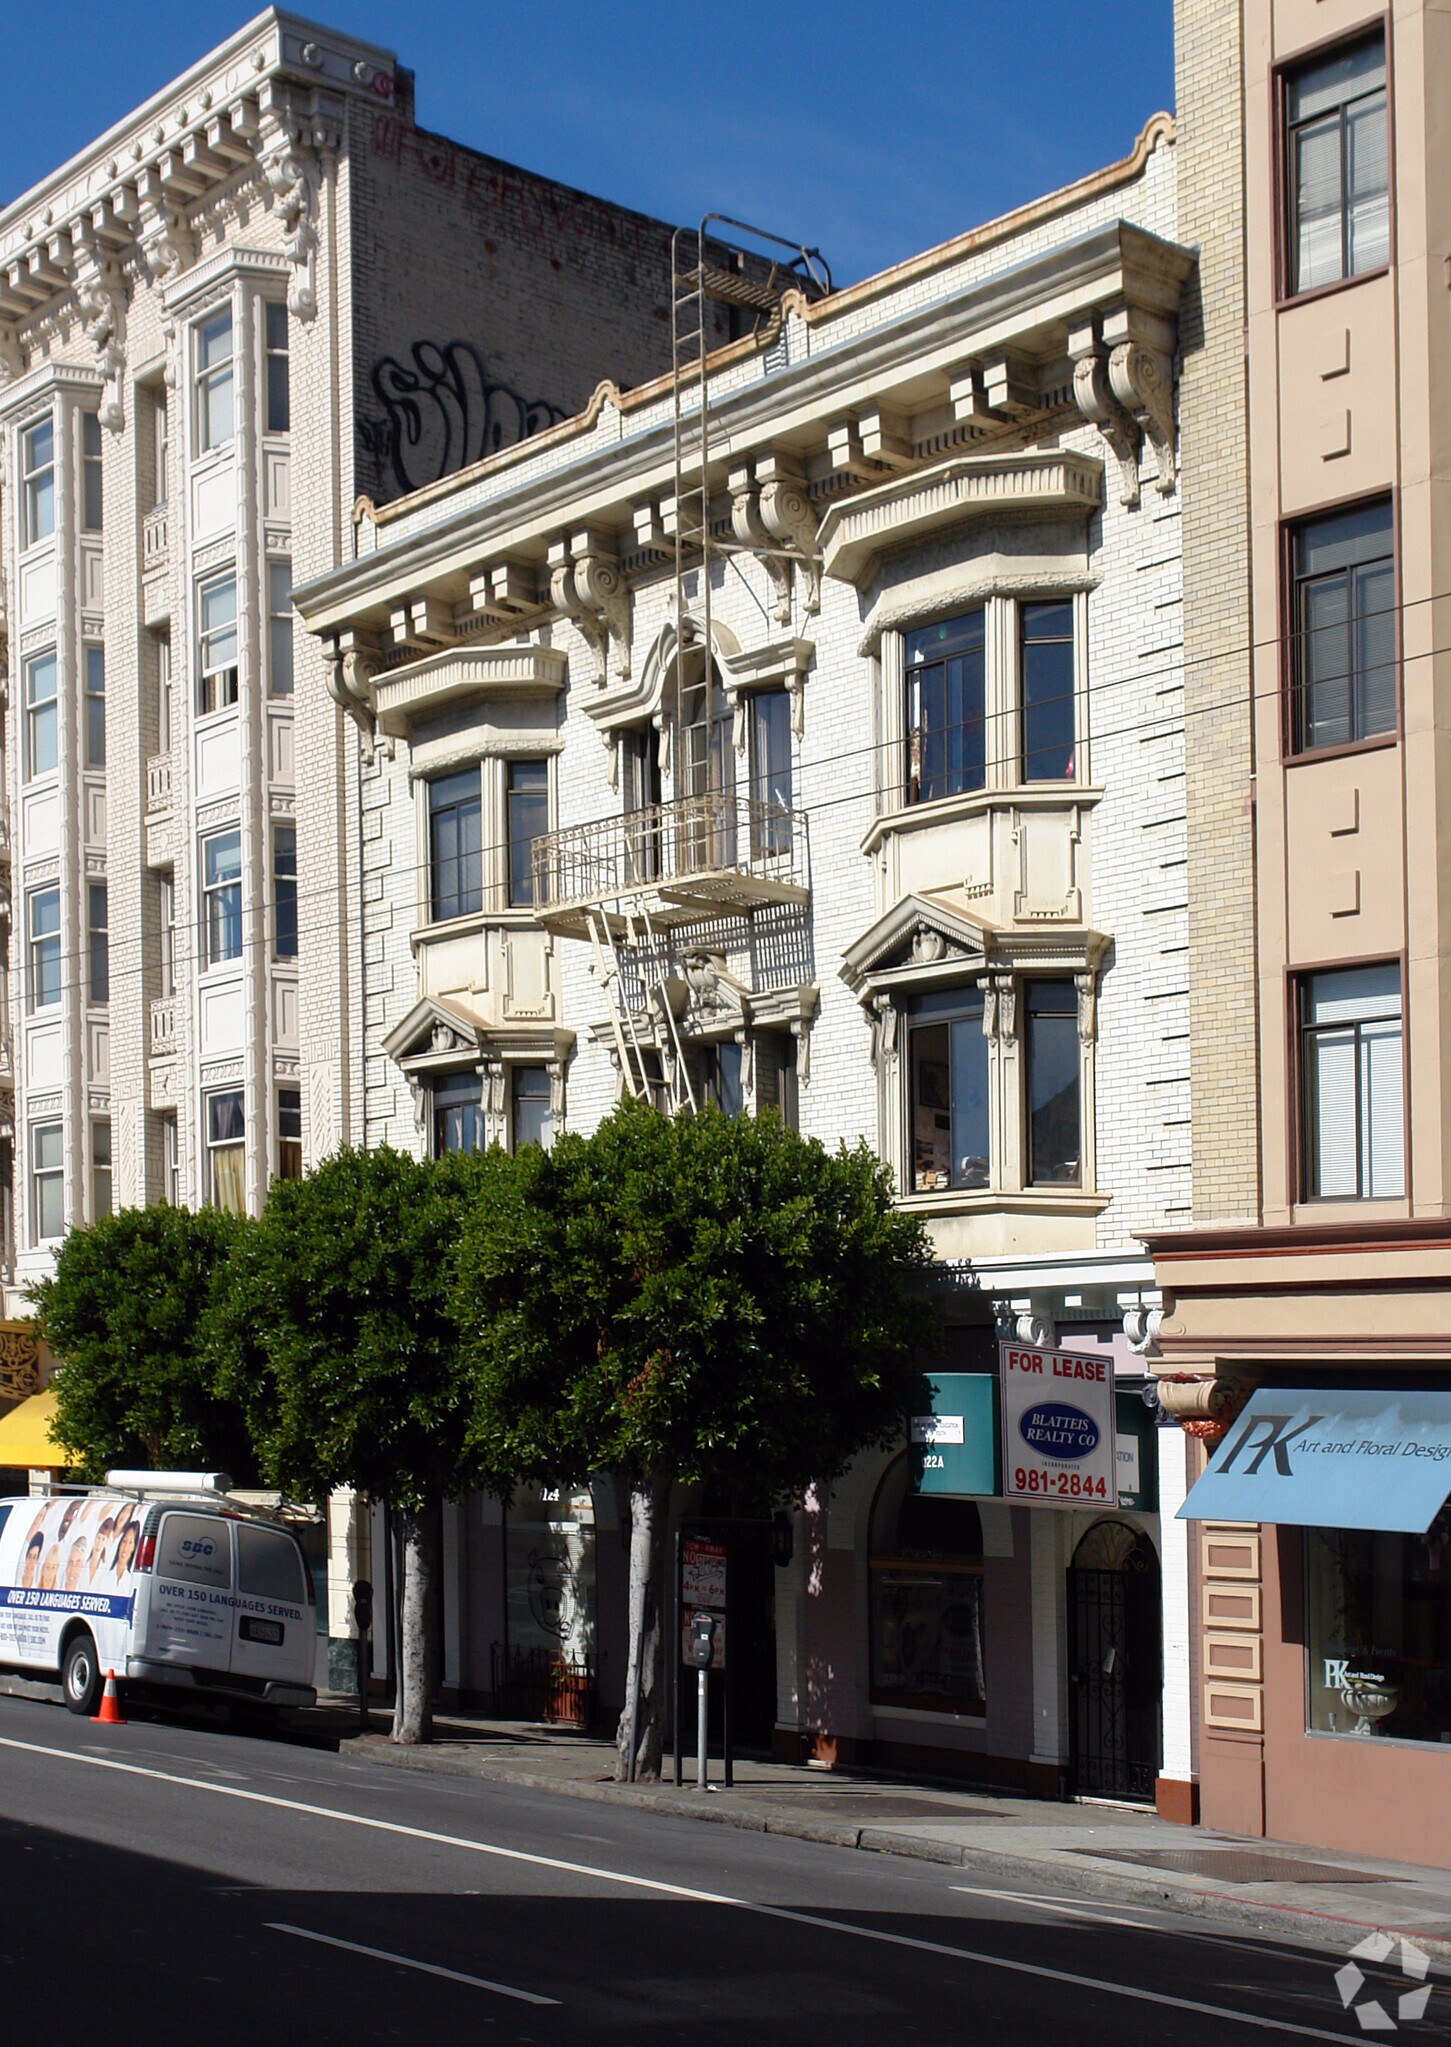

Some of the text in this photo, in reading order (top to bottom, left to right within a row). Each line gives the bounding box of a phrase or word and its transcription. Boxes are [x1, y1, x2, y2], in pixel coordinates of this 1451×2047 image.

[1009, 1352, 1106, 1382] FOR LEASE
[1031, 1413, 1089, 1431] BLATTEIS
[1026, 1428, 1096, 1447] REALTY CO
[1214, 1415, 1325, 1476] PK
[1294, 1439, 1320, 1453] Art
[1321, 1440, 1356, 1454] and
[1355, 1440, 1401, 1456] Floral
[1015, 1467, 1107, 1498] 981-2844
[181, 1540, 214, 1556] SBC
[683, 1551, 696, 1565] NO
[7, 1589, 111, 1613] OVER 150 LANGUAGES SERVED.
[159, 1584, 185, 1598] OVER
[188, 1589, 207, 1602] 150
[209, 1592, 266, 1613] LANGUAGES
[267, 1604, 303, 1622] SERVED.
[1324, 1658, 1353, 1690] PK
